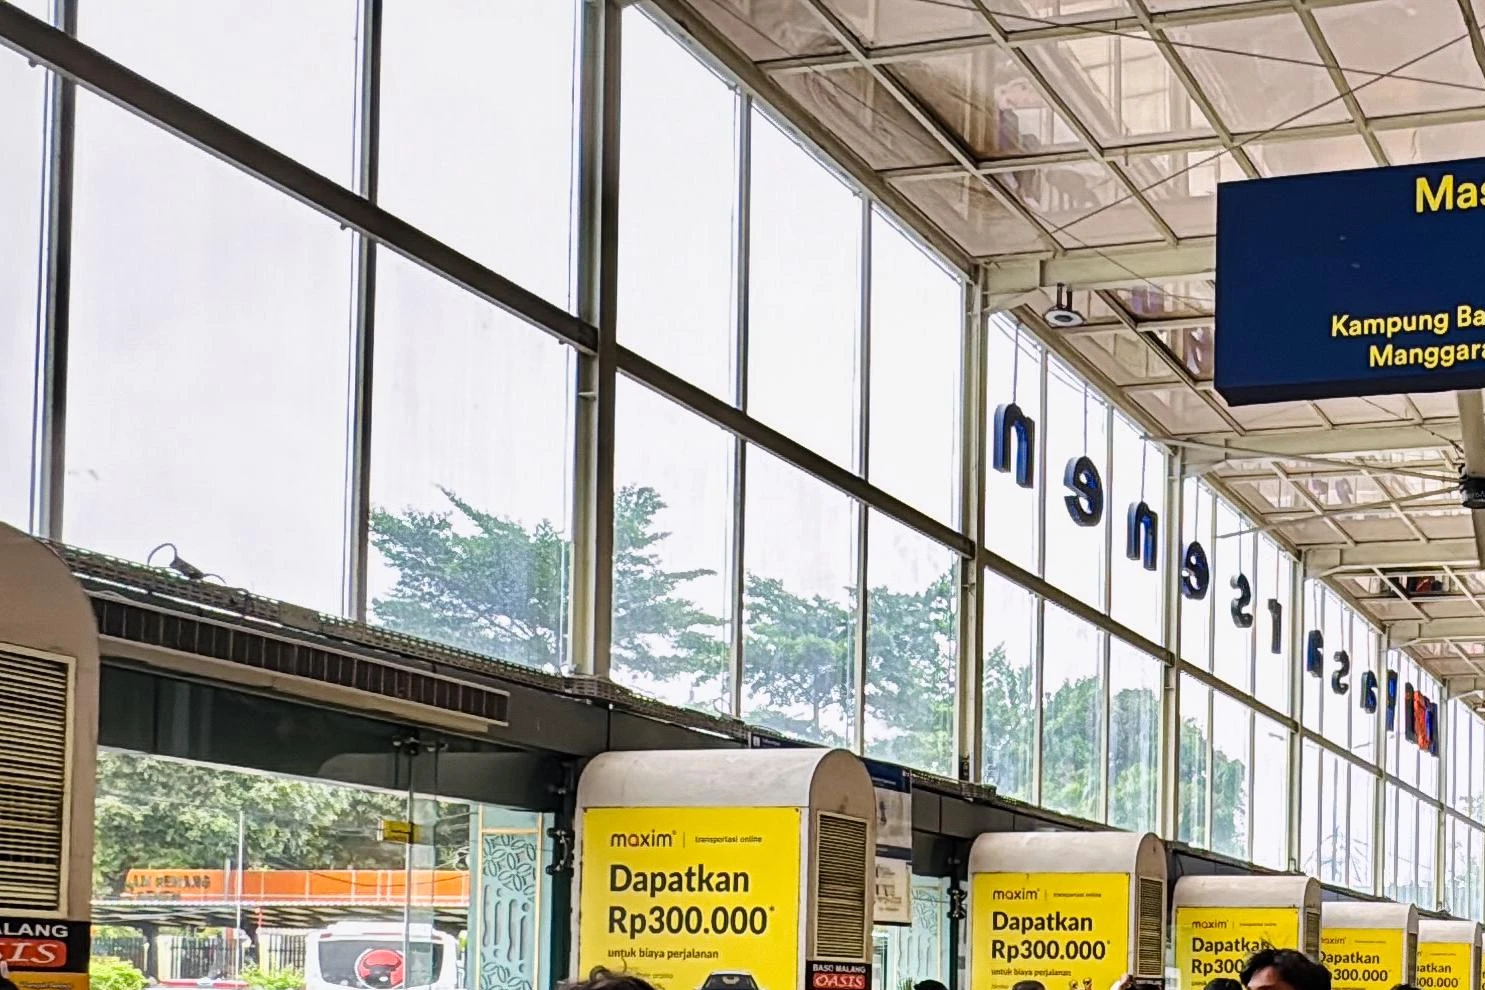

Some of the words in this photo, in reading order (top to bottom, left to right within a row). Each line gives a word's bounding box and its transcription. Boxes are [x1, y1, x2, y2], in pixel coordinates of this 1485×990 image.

[1331, 312, 1449, 339] Kampung
[610, 829, 673, 848] maxim
[609, 863, 750, 898] Dapatkan
[992, 888, 1039, 901] maxim
[608, 905, 768, 940] Rp300.000
[991, 911, 1094, 935] Dapatkan
[1191, 919, 1228, 929] maxim
[607, 947, 637, 958] untuk
[639, 947, 665, 959] biaya
[666, 948, 719, 961] perjalanan
[991, 940, 1106, 963] Rp300.000
[815, 974, 864, 988] OASIS
